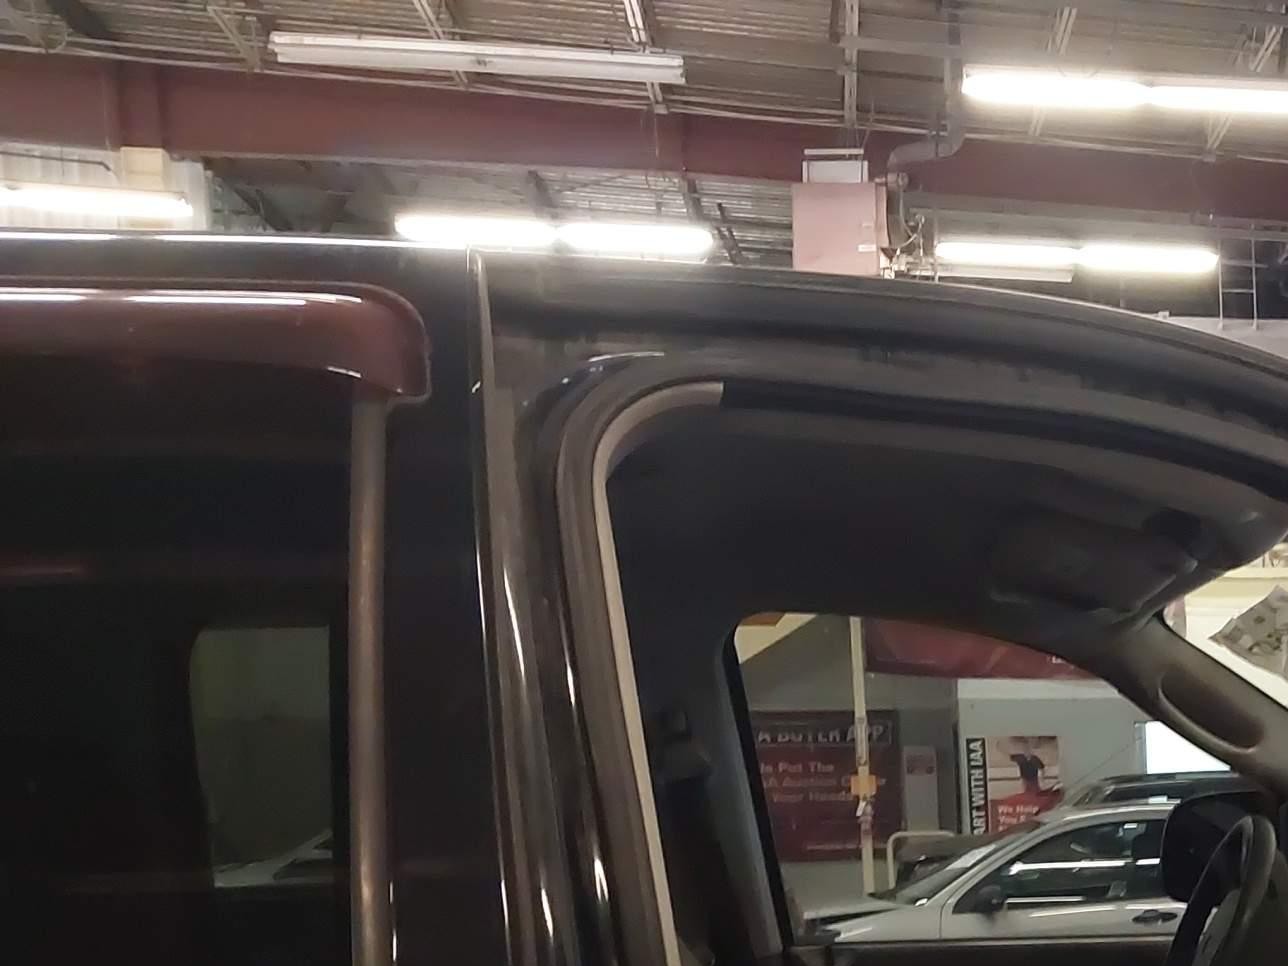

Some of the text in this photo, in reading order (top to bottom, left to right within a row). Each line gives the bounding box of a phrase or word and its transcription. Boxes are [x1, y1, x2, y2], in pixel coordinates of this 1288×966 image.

[846, 725, 884, 742] AP
[969, 740, 983, 766] IAA
[969, 768, 985, 807] WITH
